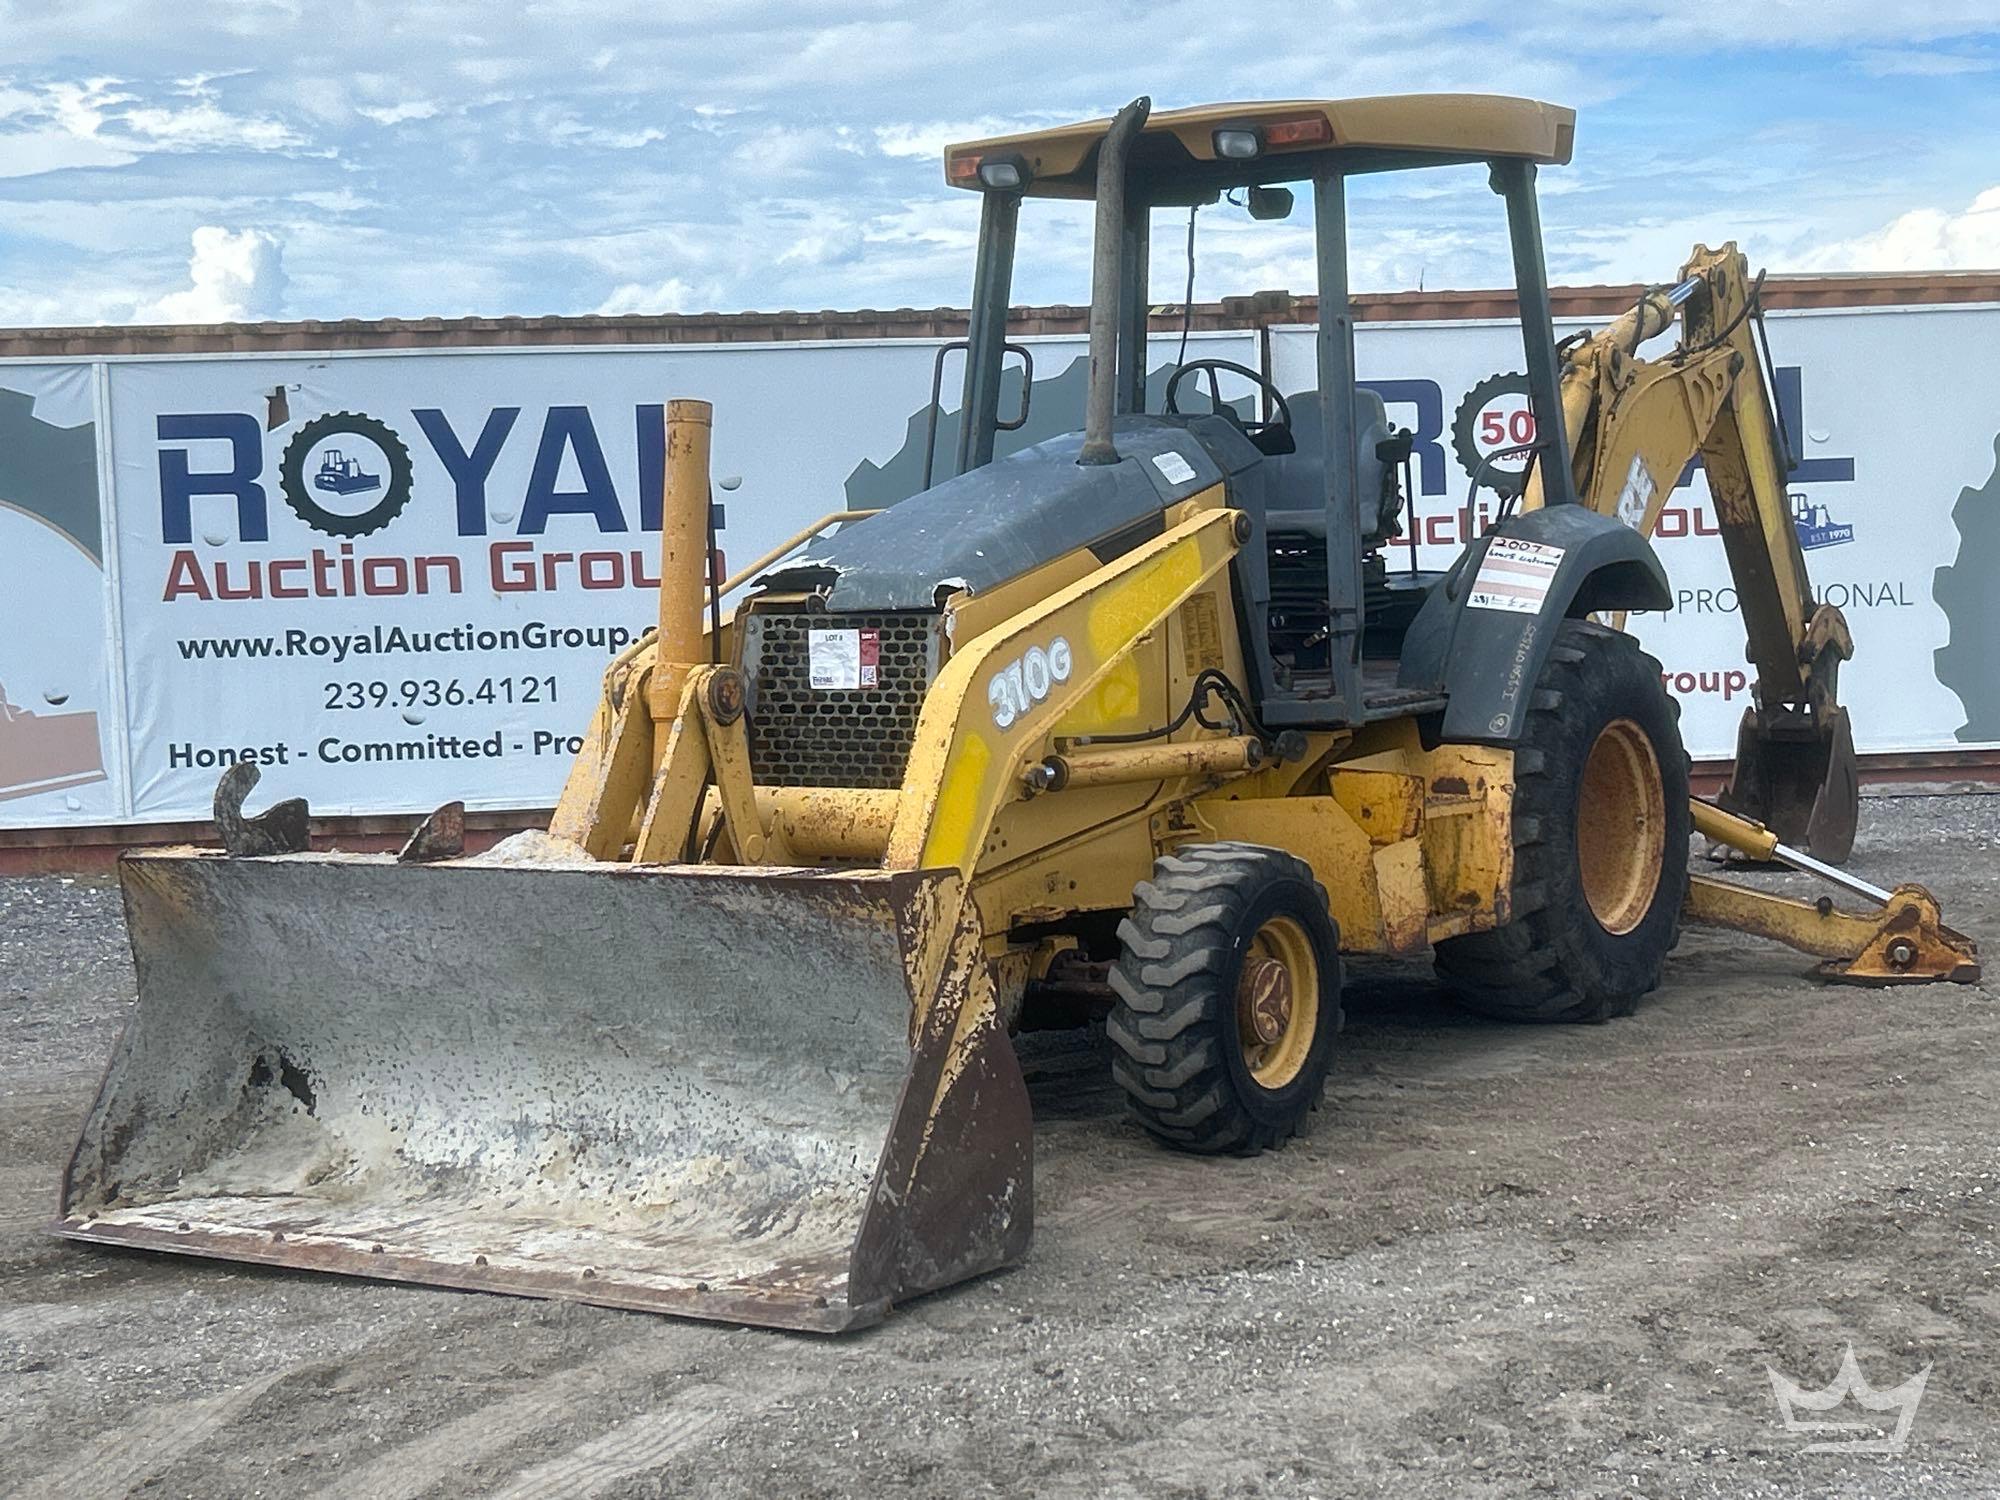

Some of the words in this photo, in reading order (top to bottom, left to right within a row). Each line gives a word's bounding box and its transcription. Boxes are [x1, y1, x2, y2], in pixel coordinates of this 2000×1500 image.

[1356, 367, 1854, 500] ROL
[1480, 410, 1534, 445] 50
[156, 404, 726, 543] ROYAL
[1829, 528, 1851, 540] 1970
[162, 543, 463, 602] Auction
[323, 676, 559, 710] 239.936.4121
[988, 634, 1073, 728] 310G
[169, 742, 289, 769] Honest
[318, 732, 503, 764] Committed
